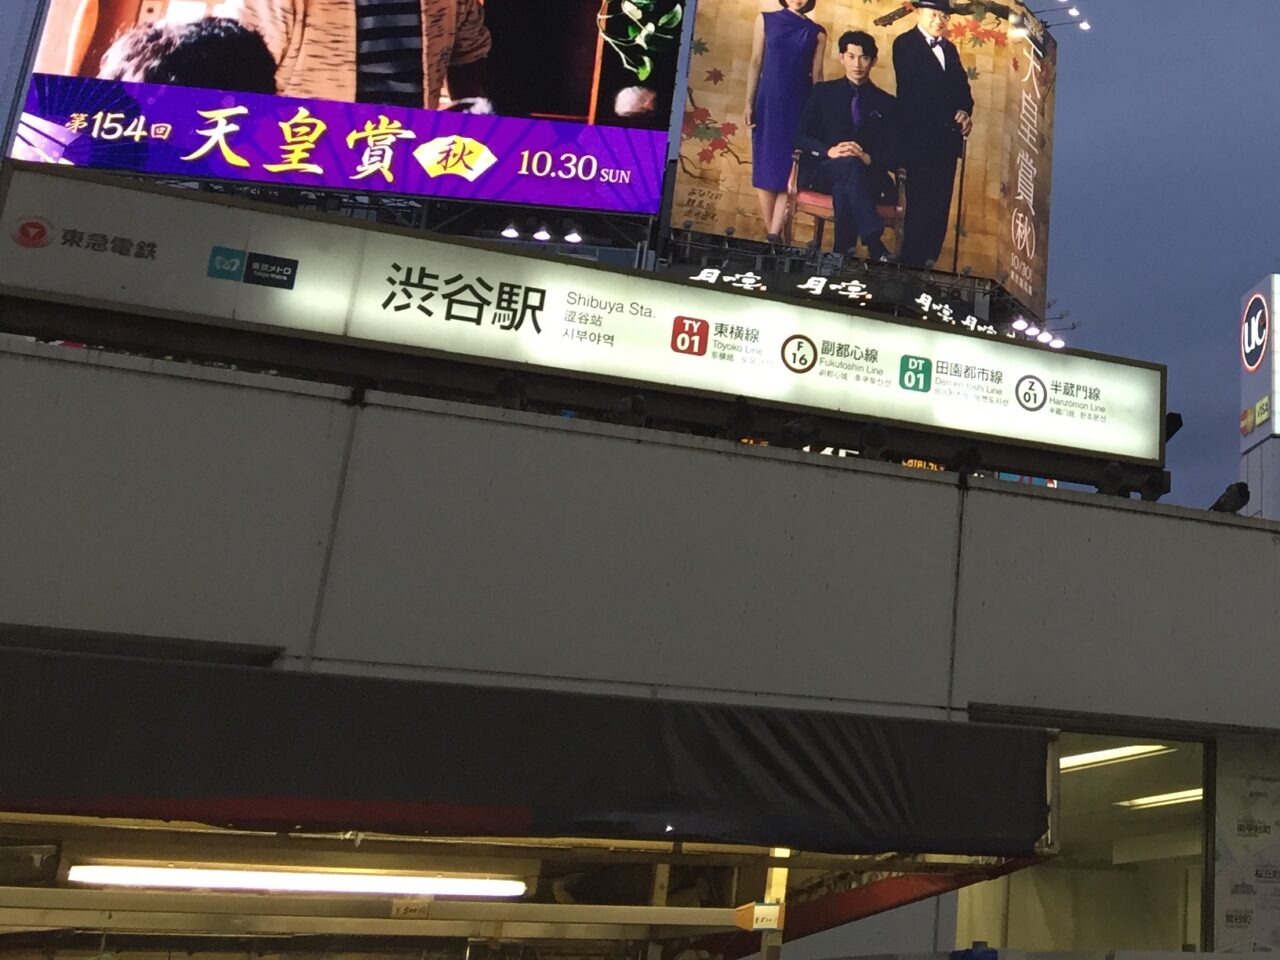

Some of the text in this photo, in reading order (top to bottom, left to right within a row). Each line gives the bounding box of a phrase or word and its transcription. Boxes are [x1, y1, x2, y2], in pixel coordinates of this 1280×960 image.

[65, 110, 172, 142] 第154回
[182, 104, 415, 185] 天皇賞
[517, 149, 597, 181] 10.30
[600, 166, 632, 185] SUN
[60, 228, 158, 261] 東急電鉄
[381, 262, 547, 334] 渋谷駅
[566, 291, 656, 319] Shibuya Sta.
[683, 319, 701, 333] TY
[713, 322, 760, 343] 東横線
[676, 333, 700, 353] 01
[713, 339, 742, 352] Toyoko
[797, 341, 804, 351] F
[821, 340, 879, 363] 副都心線
[791, 352, 808, 366] 16
[819, 357, 884, 376] Fukutoshin Line
[908, 358, 925, 371] DT
[904, 371, 925, 389] 01
[936, 360, 1003, 384] 田園都市線
[986, 385, 1003, 395] Line
[1028, 381, 1035, 391] Z
[1050, 380, 1101, 401] 半蔵門線
[1023, 392, 1038, 404] 01
[1090, 403, 1106, 413] Line
